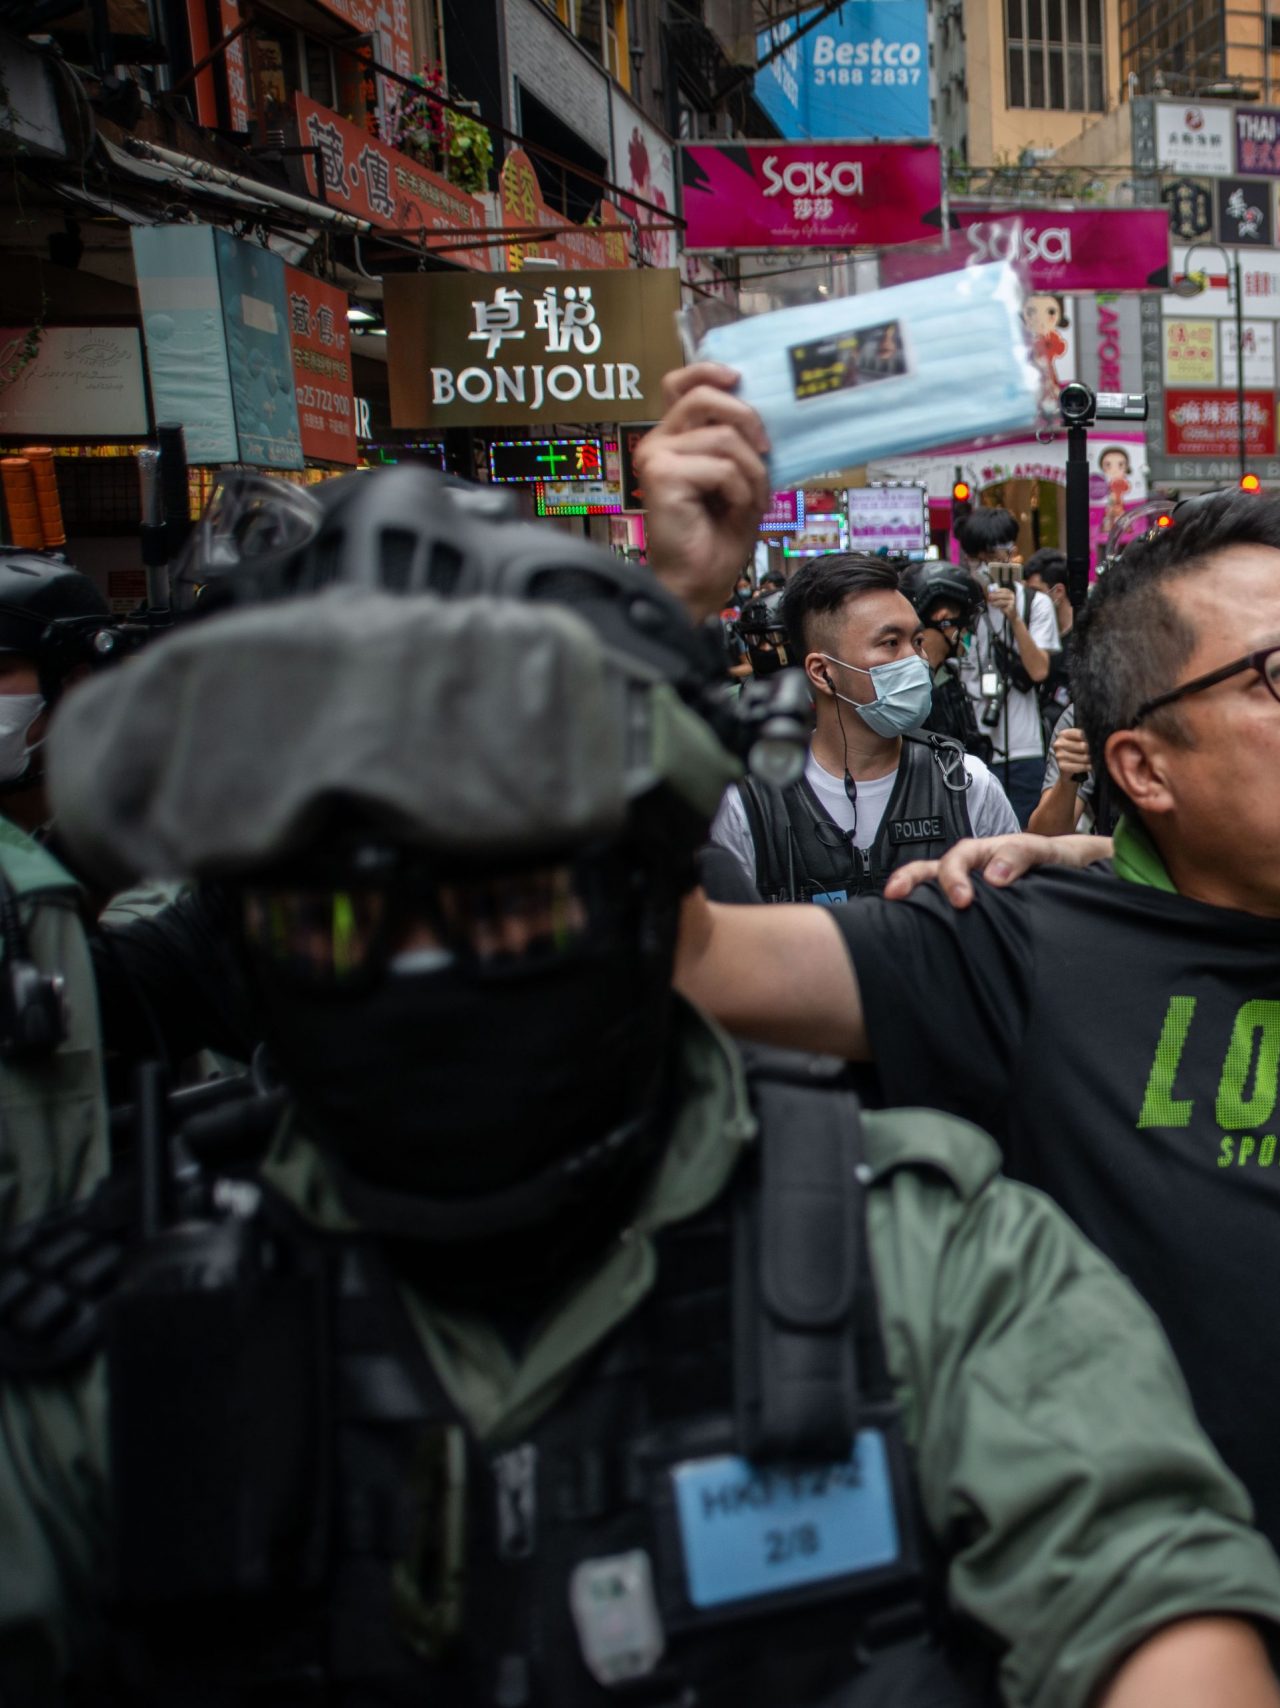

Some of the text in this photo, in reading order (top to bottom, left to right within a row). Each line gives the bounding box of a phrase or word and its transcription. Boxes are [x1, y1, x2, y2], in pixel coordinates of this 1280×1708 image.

[813, 35, 921, 66] Bestco
[814, 68, 863, 86] 3188
[430, 363, 644, 410] BONJOUR
[894, 819, 941, 839] POLICE
